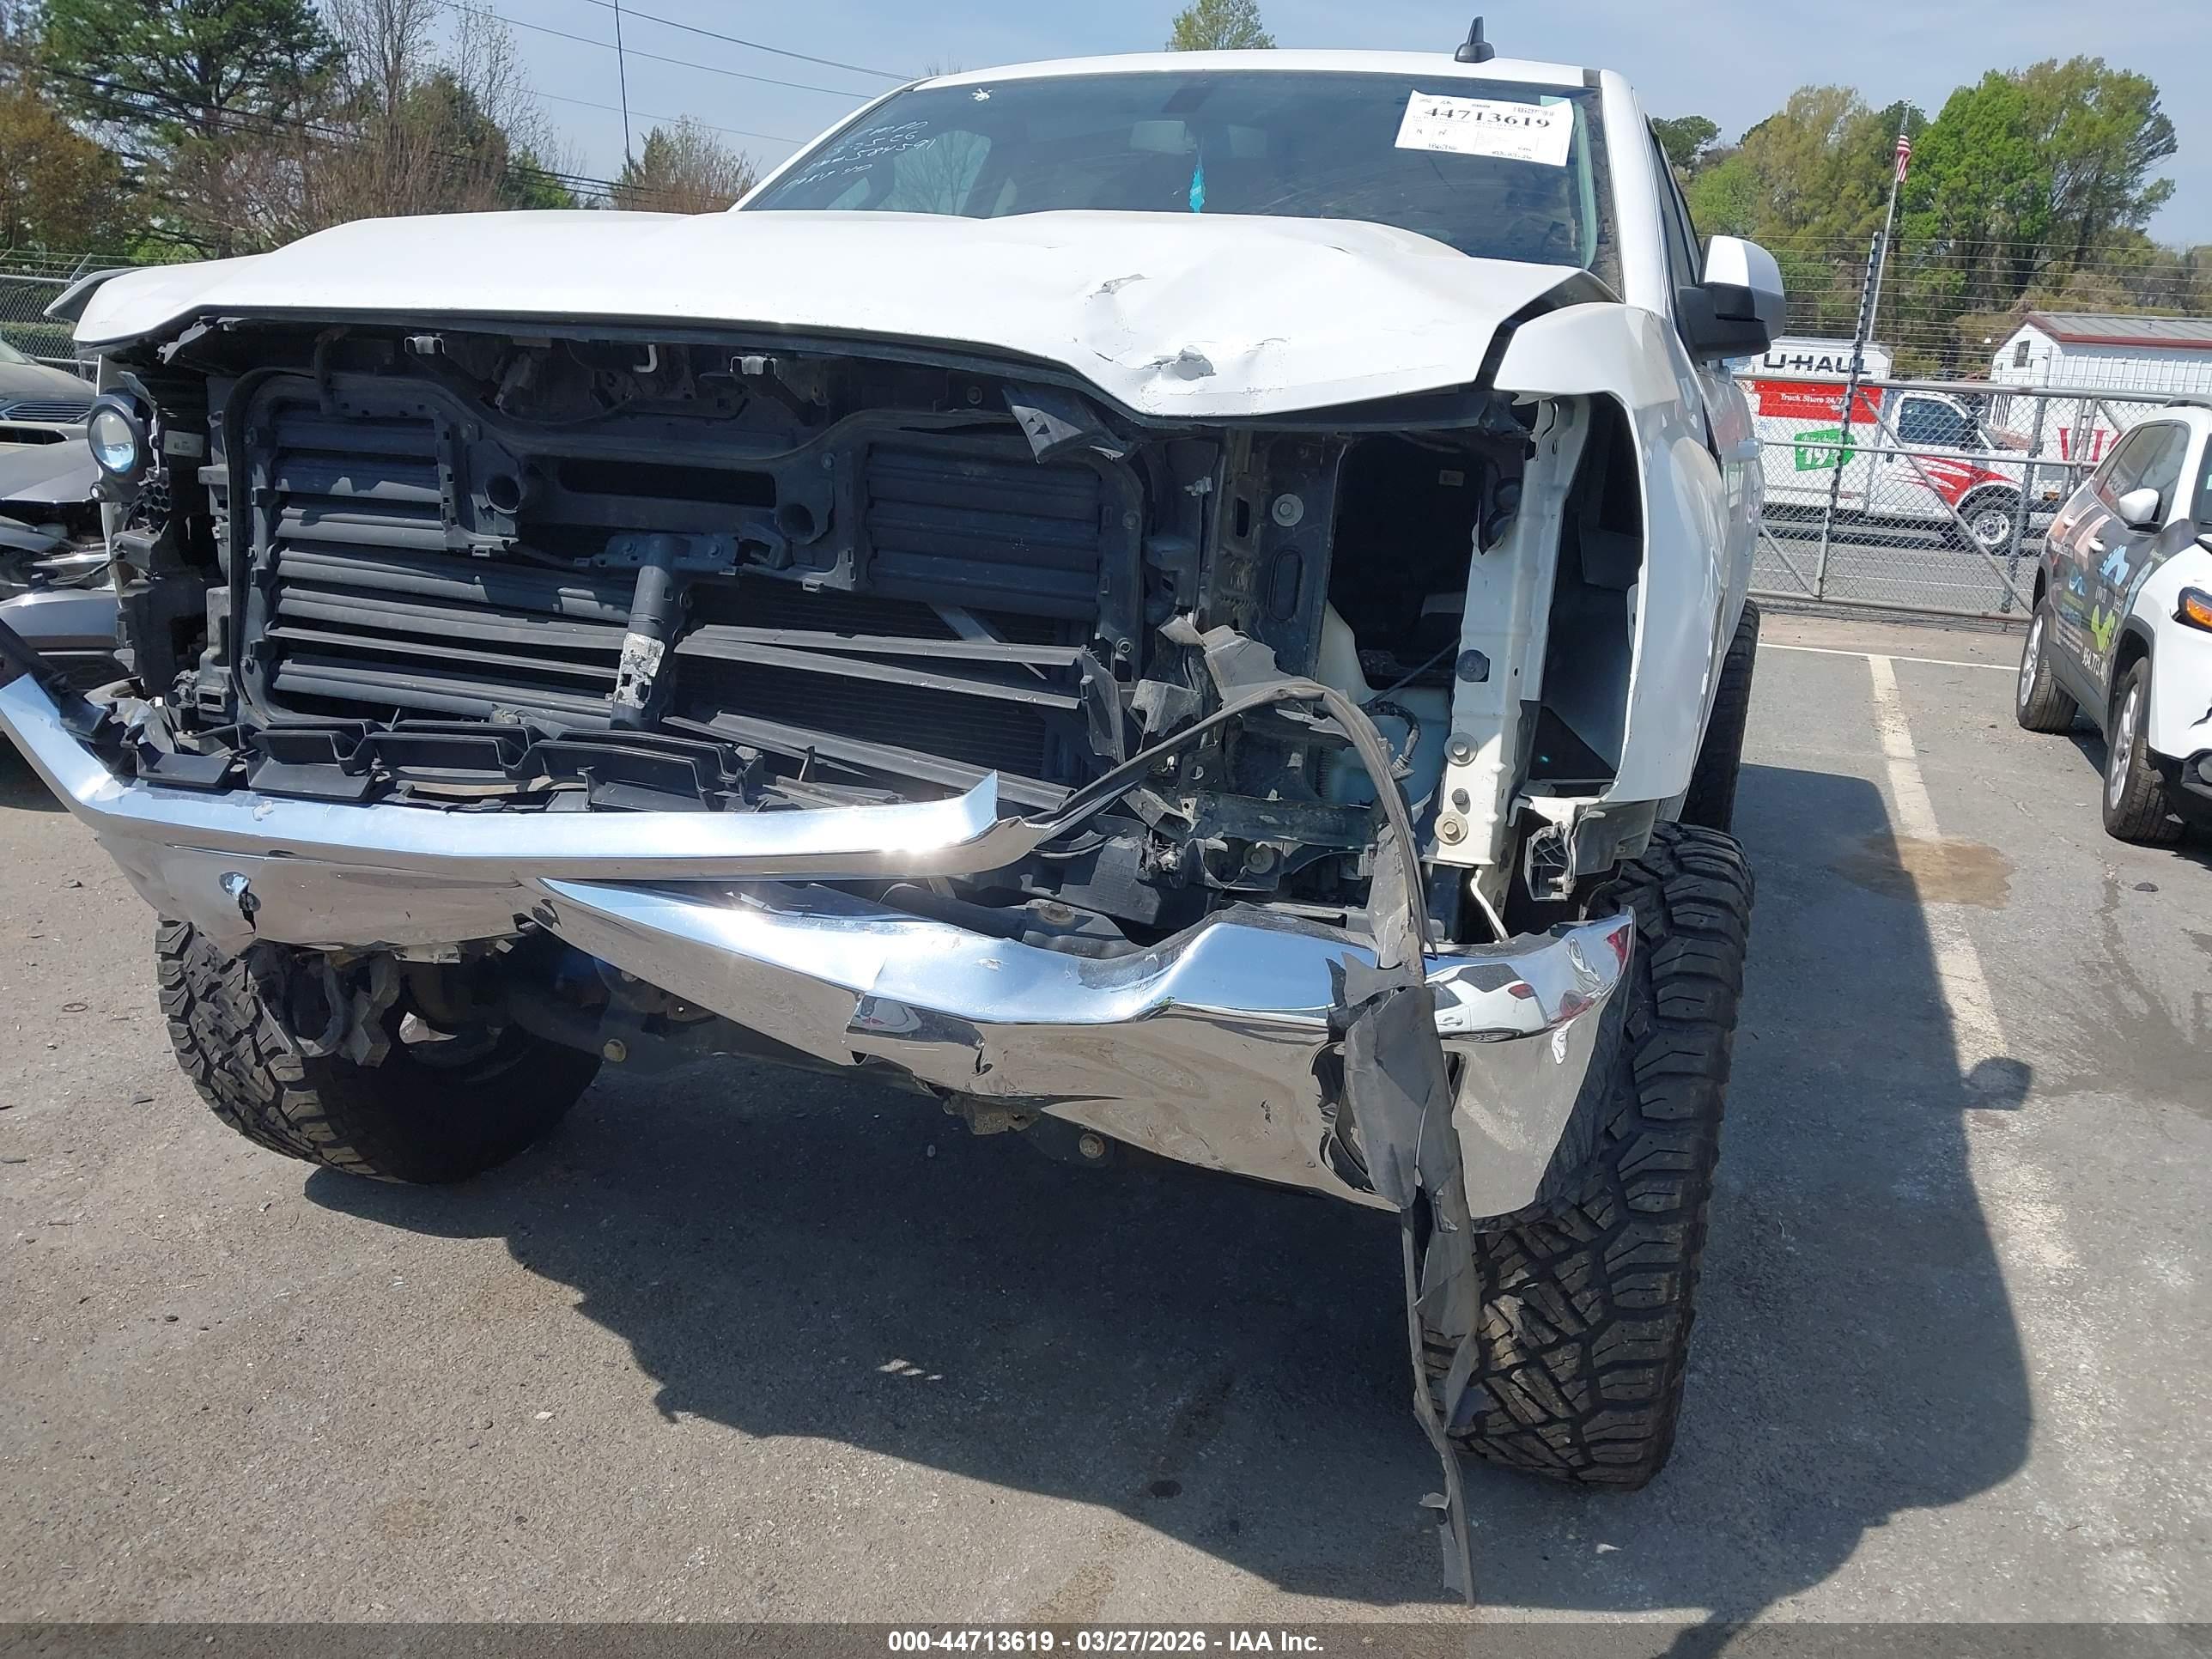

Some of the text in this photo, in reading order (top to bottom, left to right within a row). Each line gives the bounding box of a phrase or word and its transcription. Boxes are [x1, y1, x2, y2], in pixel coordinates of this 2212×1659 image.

[1425, 106, 1551, 129] 44713619
[1780, 392, 1844, 405] Truck Share 24/7
